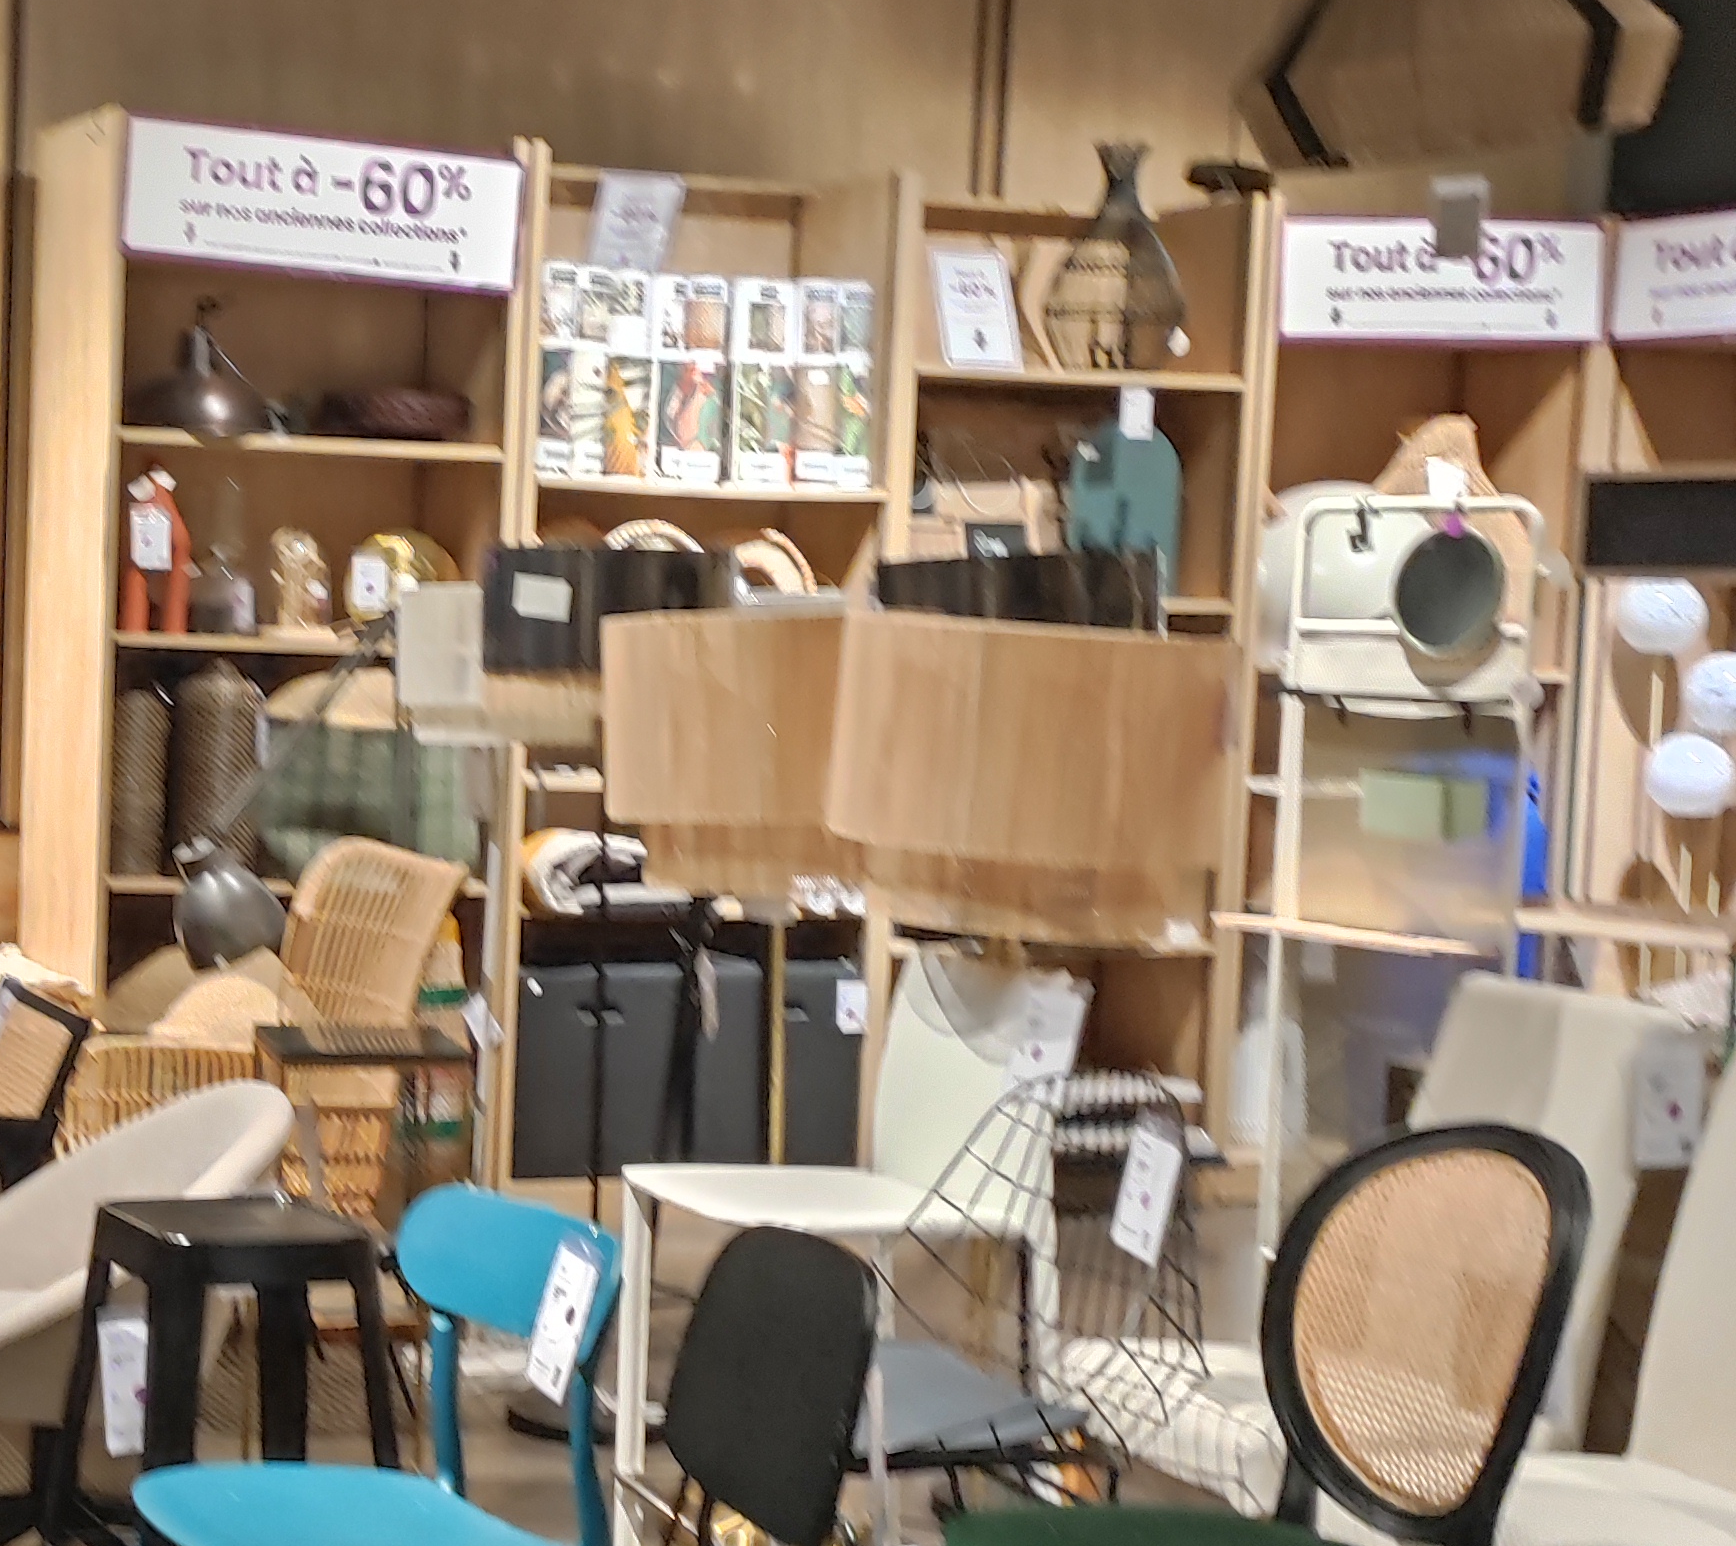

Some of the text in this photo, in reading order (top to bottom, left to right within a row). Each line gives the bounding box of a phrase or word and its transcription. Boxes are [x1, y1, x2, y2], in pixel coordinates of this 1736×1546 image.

[184, 145, 472, 218] Tout à -60%
[1328, 235, 1411, 274] Tout
